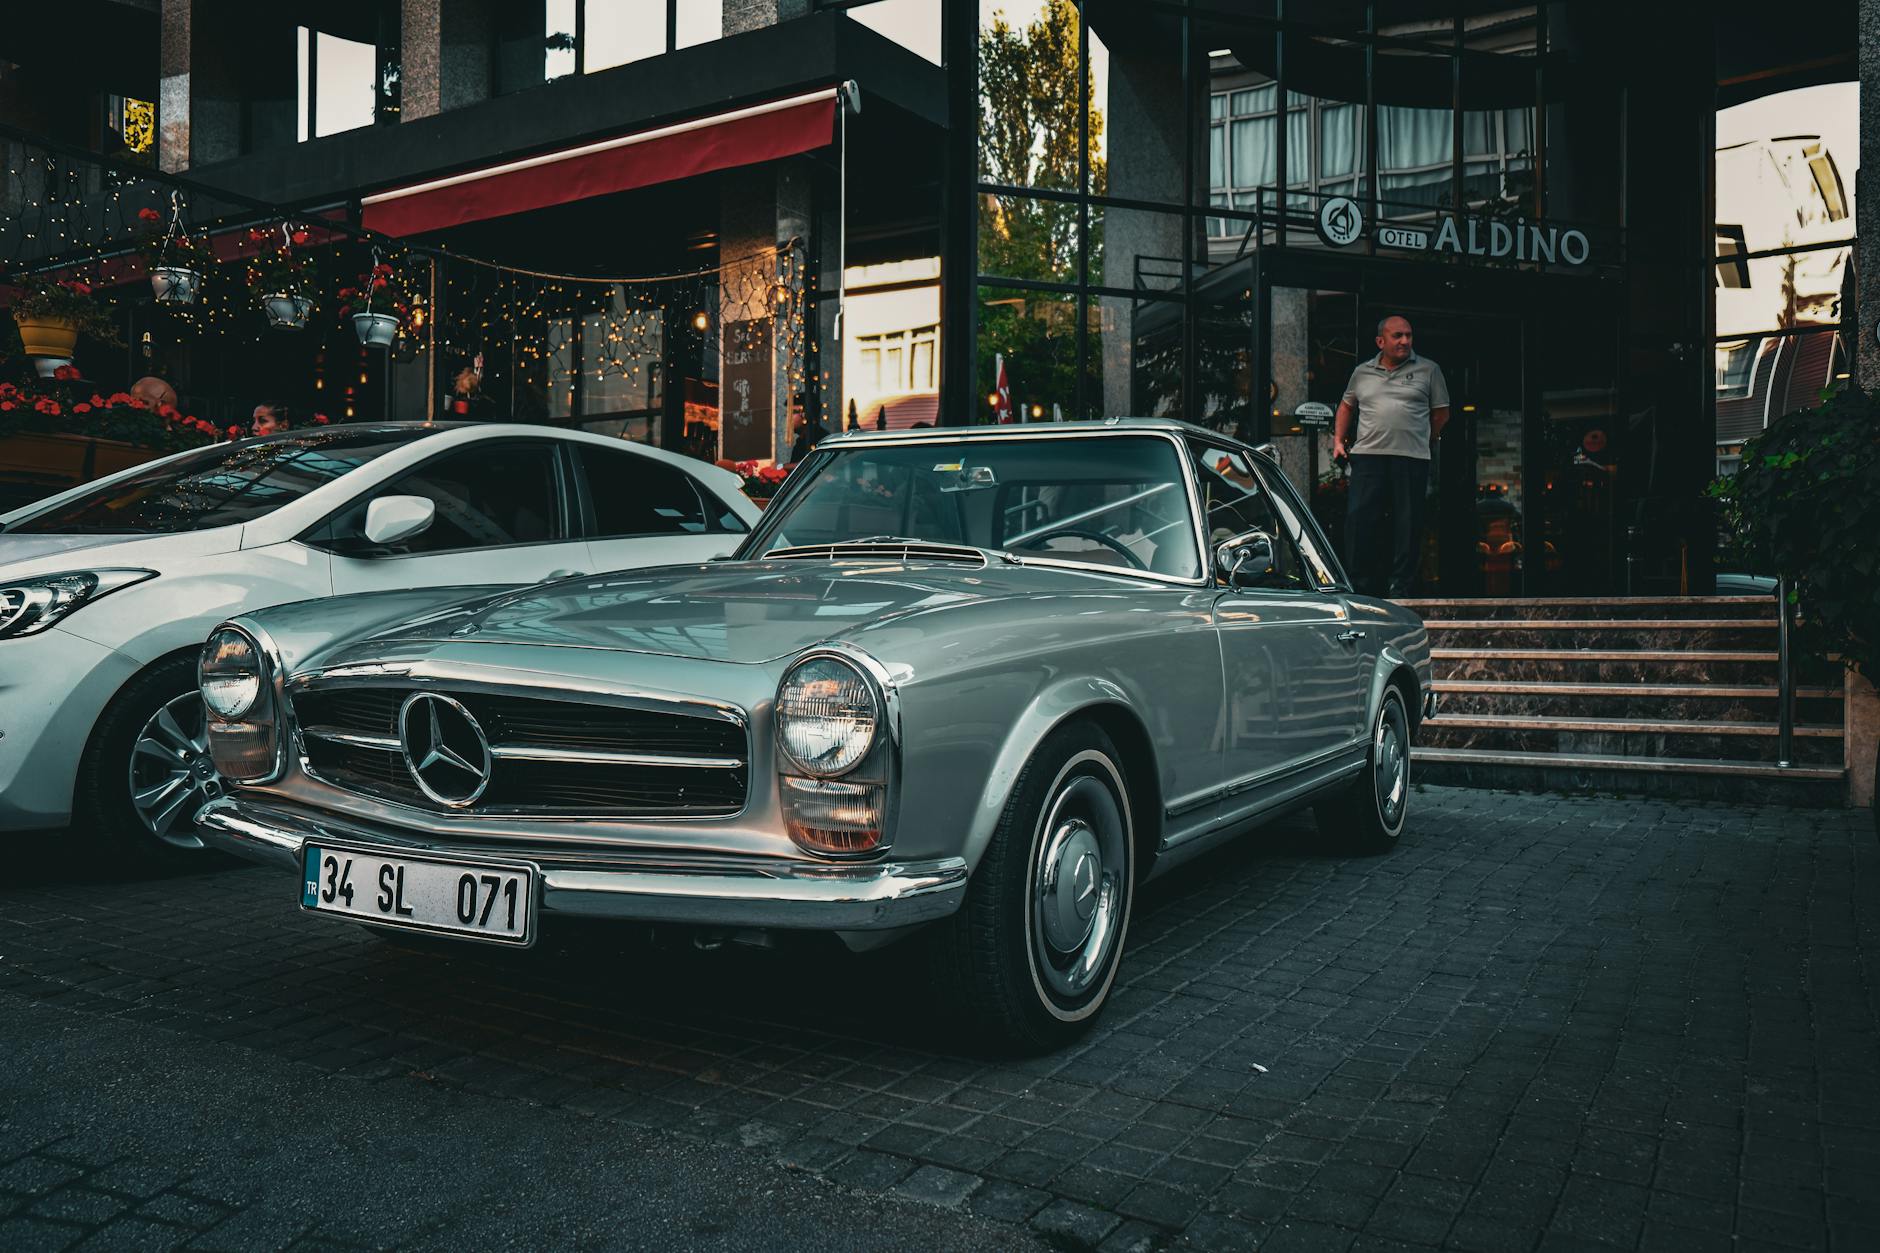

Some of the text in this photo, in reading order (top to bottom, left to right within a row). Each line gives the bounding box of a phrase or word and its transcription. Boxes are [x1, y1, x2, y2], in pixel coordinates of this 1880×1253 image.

[1385, 230, 1421, 247] OTEL
[307, 880, 317, 895] TR
[322, 855, 518, 930] 34 SL 071
